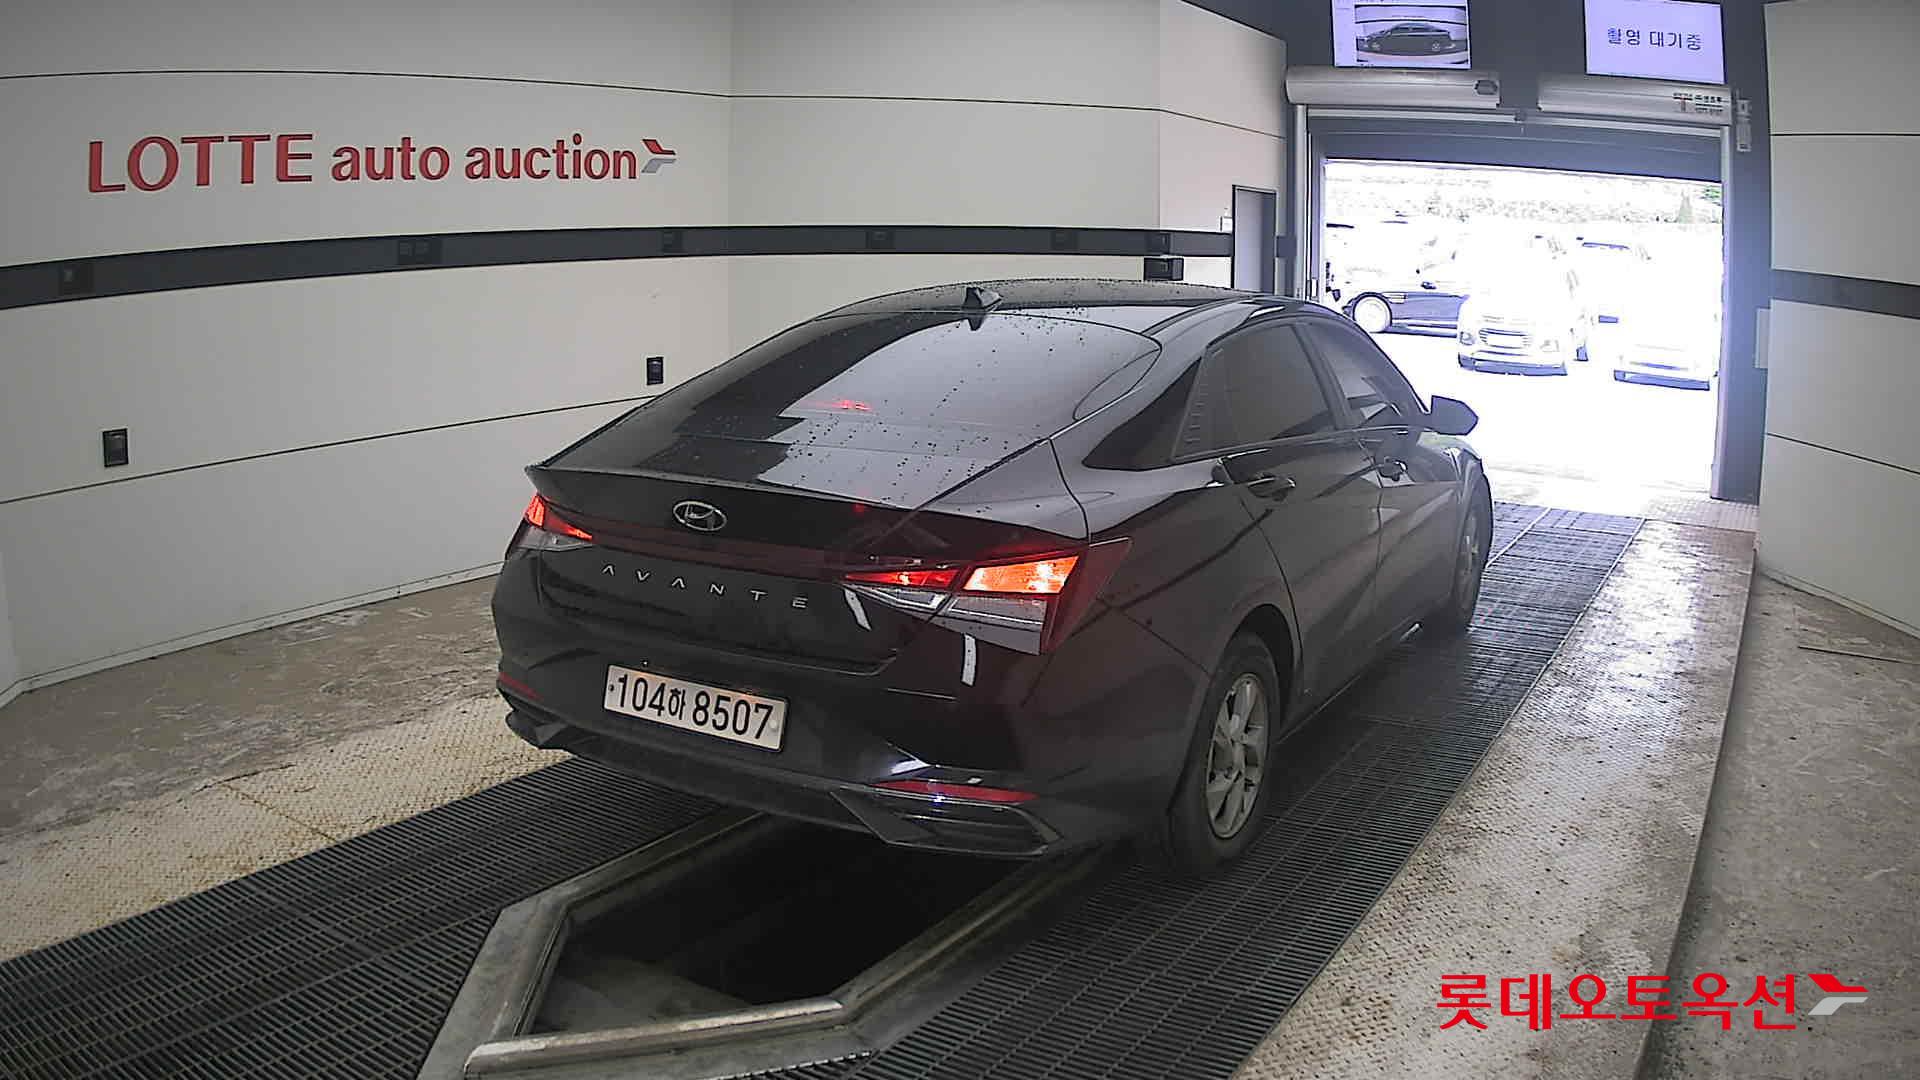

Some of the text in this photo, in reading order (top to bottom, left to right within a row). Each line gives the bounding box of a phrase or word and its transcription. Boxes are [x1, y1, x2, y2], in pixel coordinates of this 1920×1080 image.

[88, 132, 638, 193] LOTTE auto auction
[602, 564, 808, 609] AVANTE
[617, 673, 774, 740] 104하 8507
